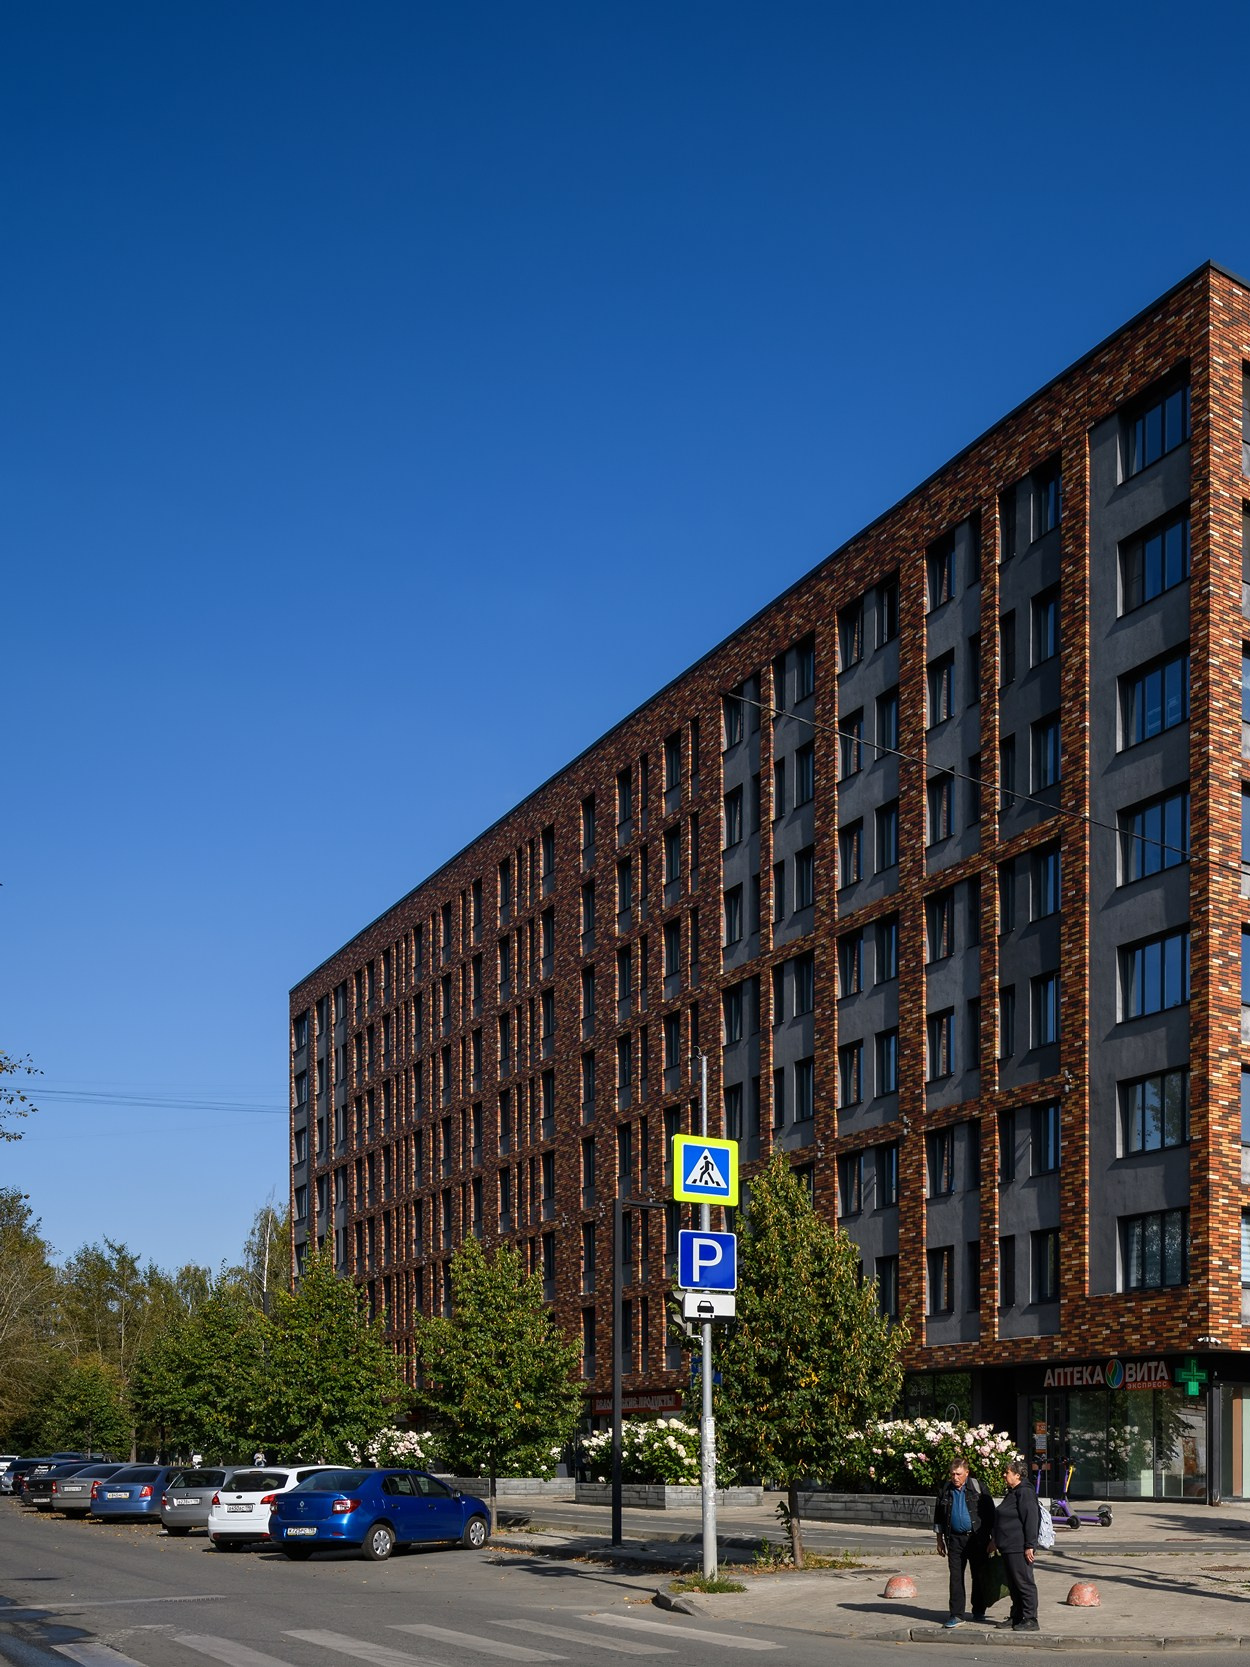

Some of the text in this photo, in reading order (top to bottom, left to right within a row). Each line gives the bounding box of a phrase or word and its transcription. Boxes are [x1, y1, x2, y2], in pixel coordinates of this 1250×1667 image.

[692, 1238, 723, 1282] P
[1044, 1361, 1169, 1388] АПТЕКА ВИТА
[1127, 1381, 1168, 1390] ЭКСПРЕСС
